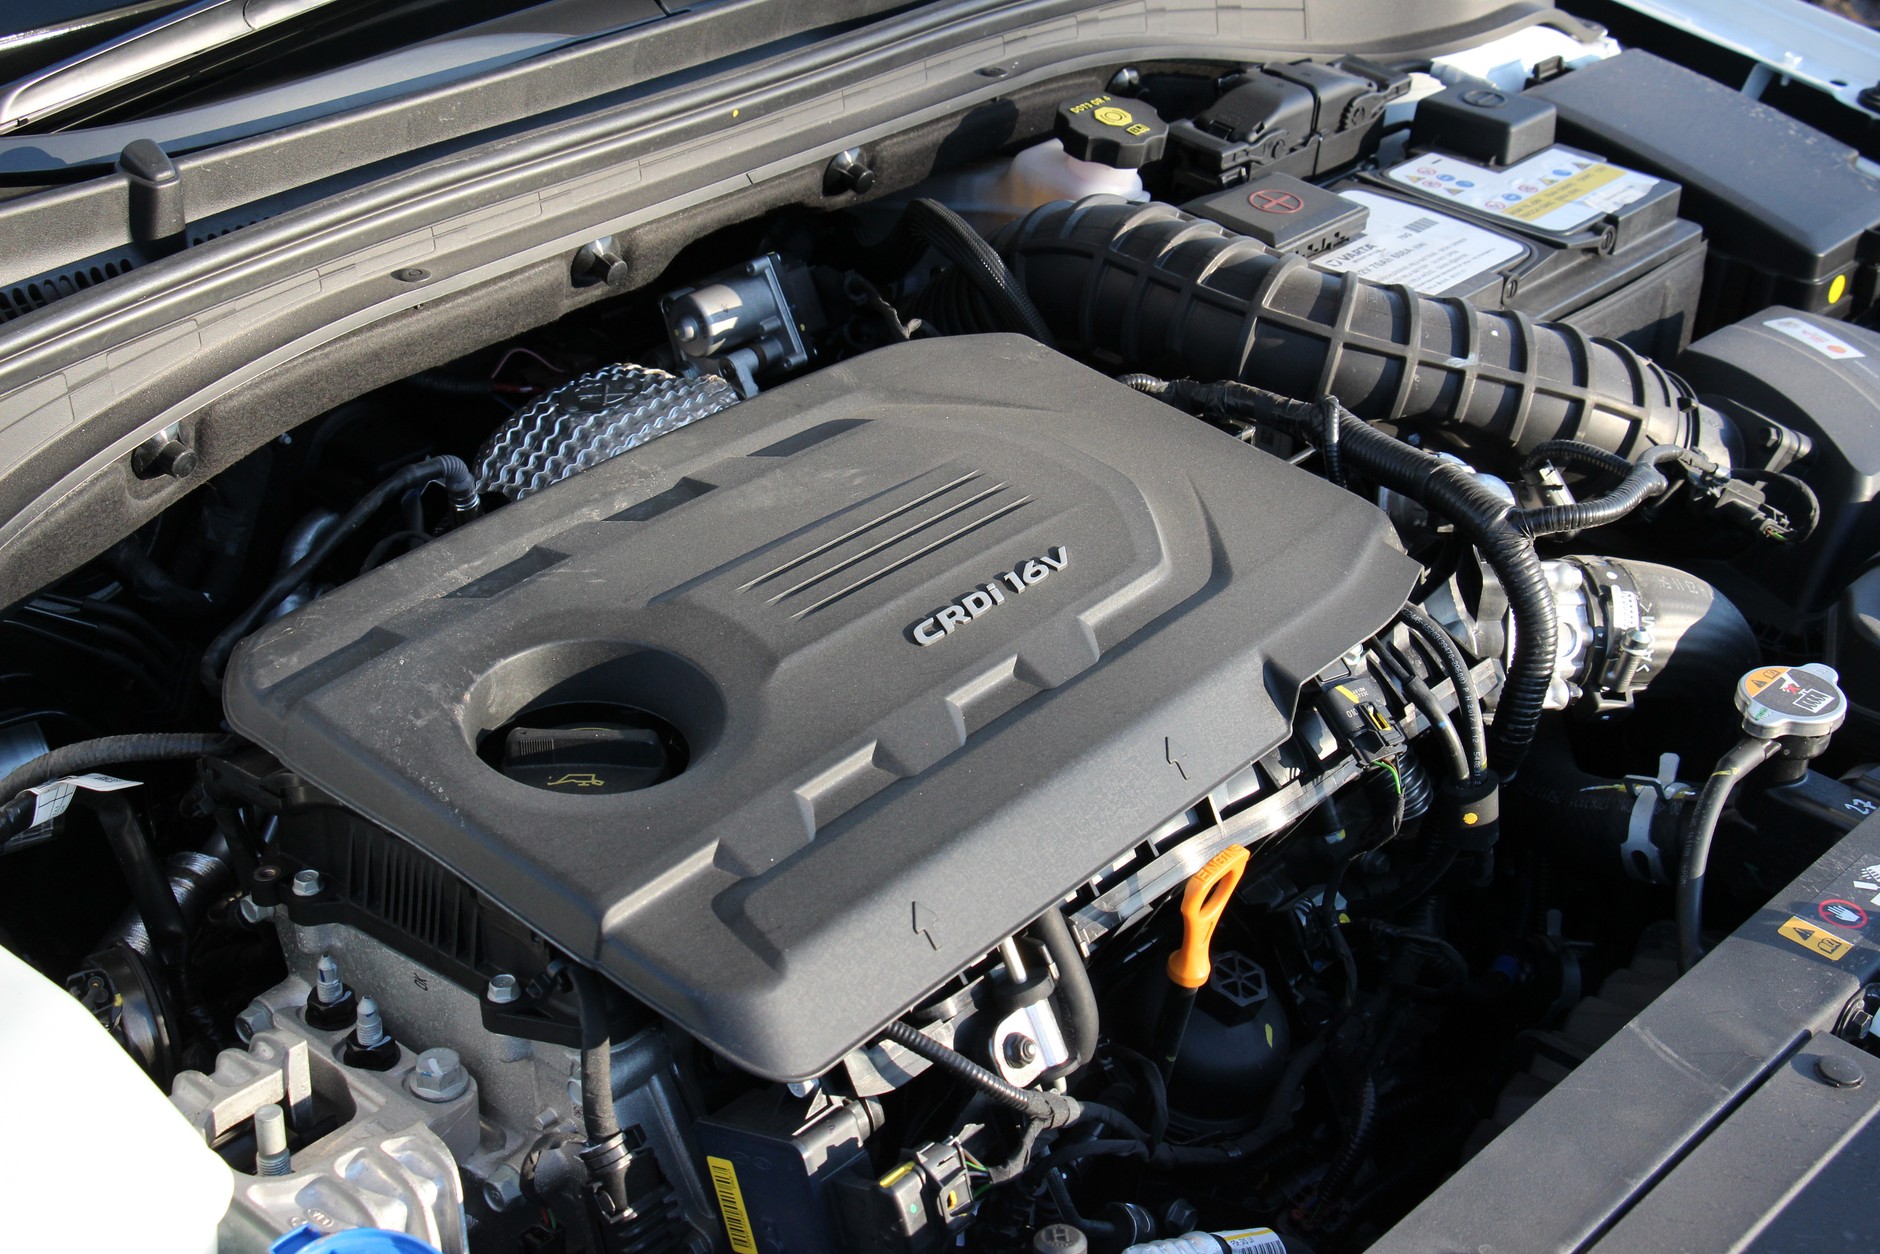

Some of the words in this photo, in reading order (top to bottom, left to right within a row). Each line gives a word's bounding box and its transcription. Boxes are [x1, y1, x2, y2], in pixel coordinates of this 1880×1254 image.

[1341, 243, 1377, 261] VARTA
[913, 583, 1005, 647] CRDi
[1003, 546, 1069, 594] 16V
[1192, 844, 1241, 883] ENGINE
